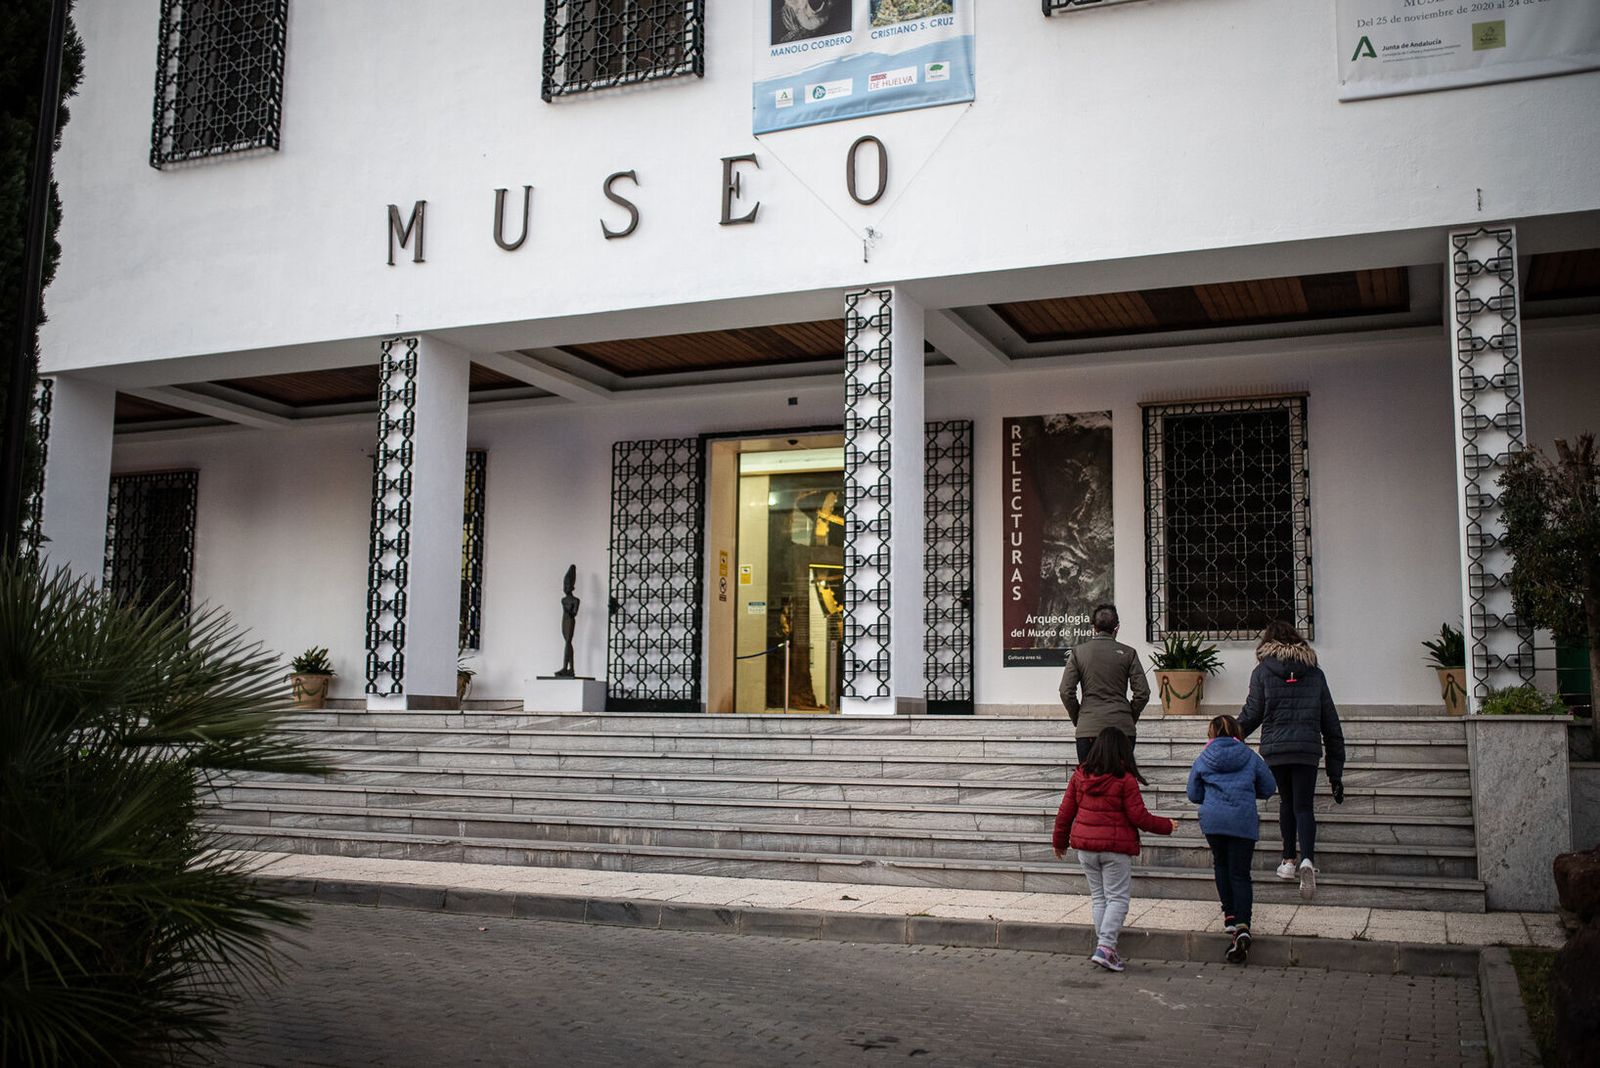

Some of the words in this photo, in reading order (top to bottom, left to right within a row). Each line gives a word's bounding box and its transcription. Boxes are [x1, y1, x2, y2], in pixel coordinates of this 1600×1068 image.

[1357, 18, 1374, 28] Del
[1376, 16, 1388, 25] 25
[1390, 15, 1401, 23] de
[1404, 9, 1454, 22] noviembre
[1456, 5, 1468, 14] de
[1471, 1, 1494, 12] 2020
[871, 23, 917, 40] CRISTIANO
[920, 22, 928, 30] S.
[930, 17, 954, 28] CRUZ
[770, 43, 809, 57] MANOLO
[811, 35, 852, 50] CORDERO
[1382, 44, 1399, 52] Junta
[1410, 39, 1442, 48] Andalucía
[882, 75, 913, 87] HUELVA
[387, 135, 888, 266] MUSEO
[1011, 425, 1023, 601] RELECTURAS
[1025, 613, 1090, 625] Arqueología
[1010, 629, 1025, 638] del
[1027, 629, 1056, 638] Museo
[1059, 628, 1070, 637] de
[1073, 628, 1098, 637] Huel
